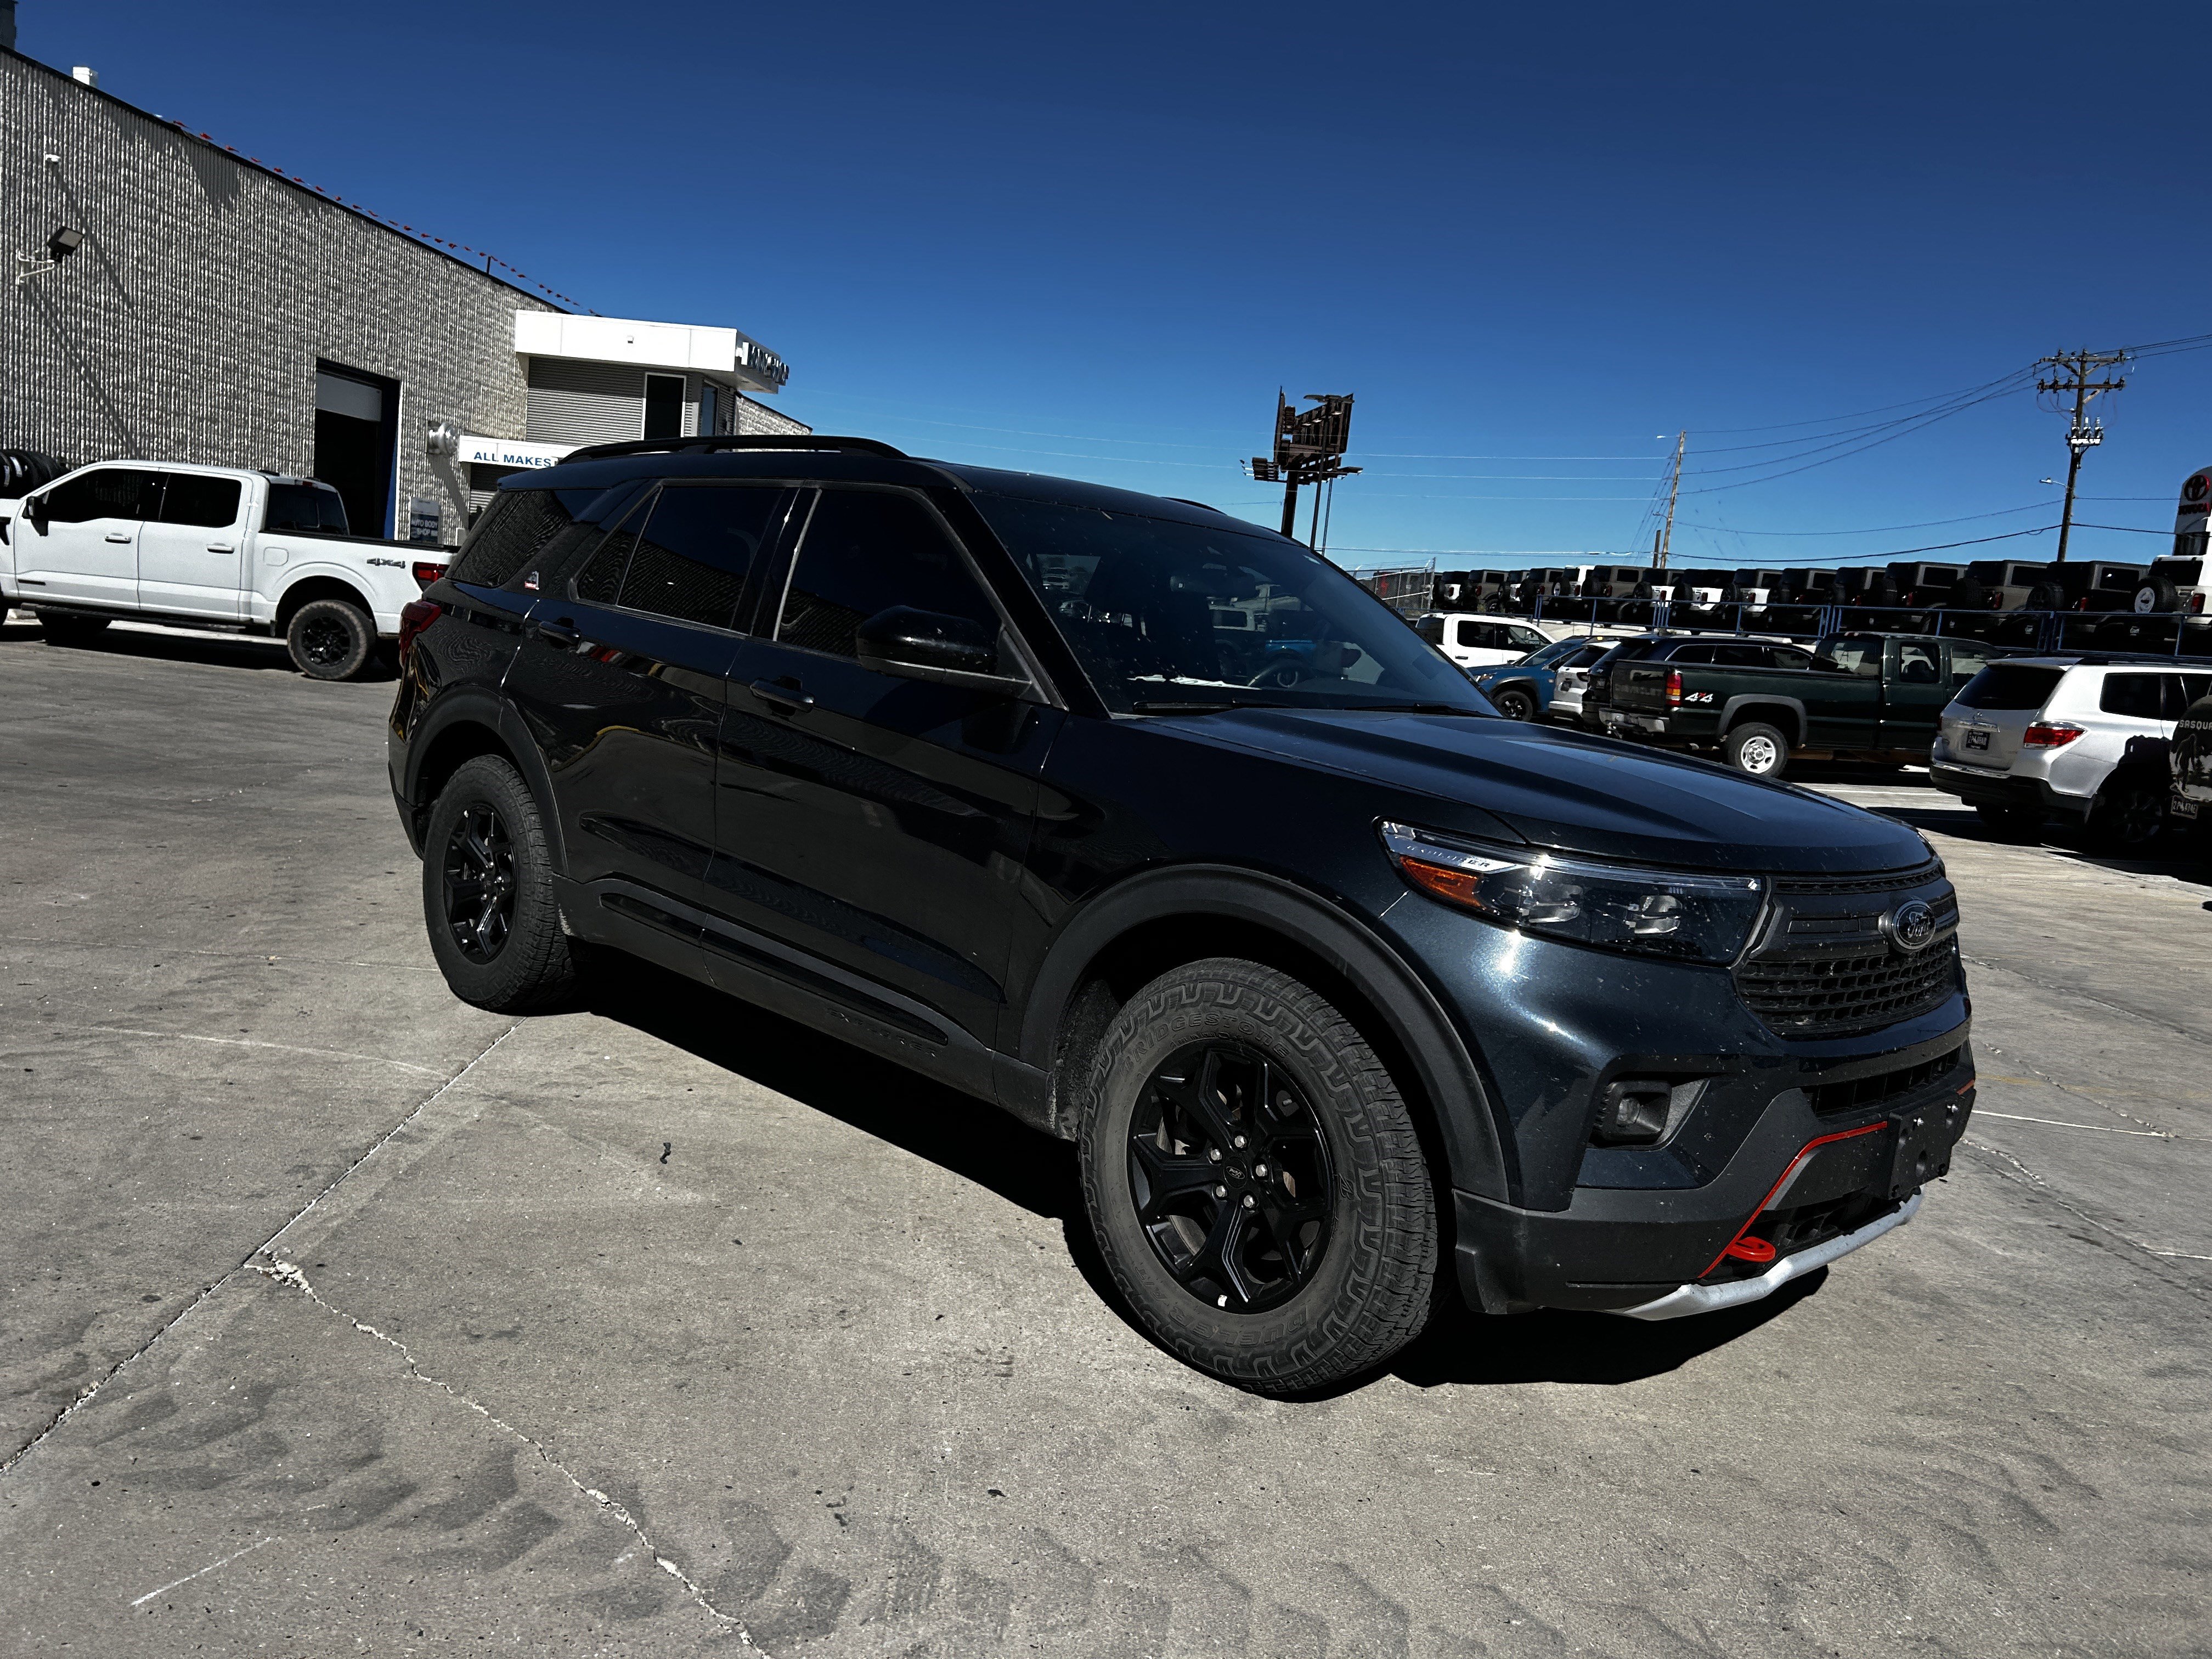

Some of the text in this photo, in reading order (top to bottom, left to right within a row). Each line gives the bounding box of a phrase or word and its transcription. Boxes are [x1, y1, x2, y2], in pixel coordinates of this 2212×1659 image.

[473, 452, 551, 466] ALL MAKES
[425, 520, 438, 528] BODY
[1908, 911, 1931, 938] Ford
[1119, 1012, 1290, 1076] BRIDGESTONE
[1169, 1306, 1307, 1347] DUELER
